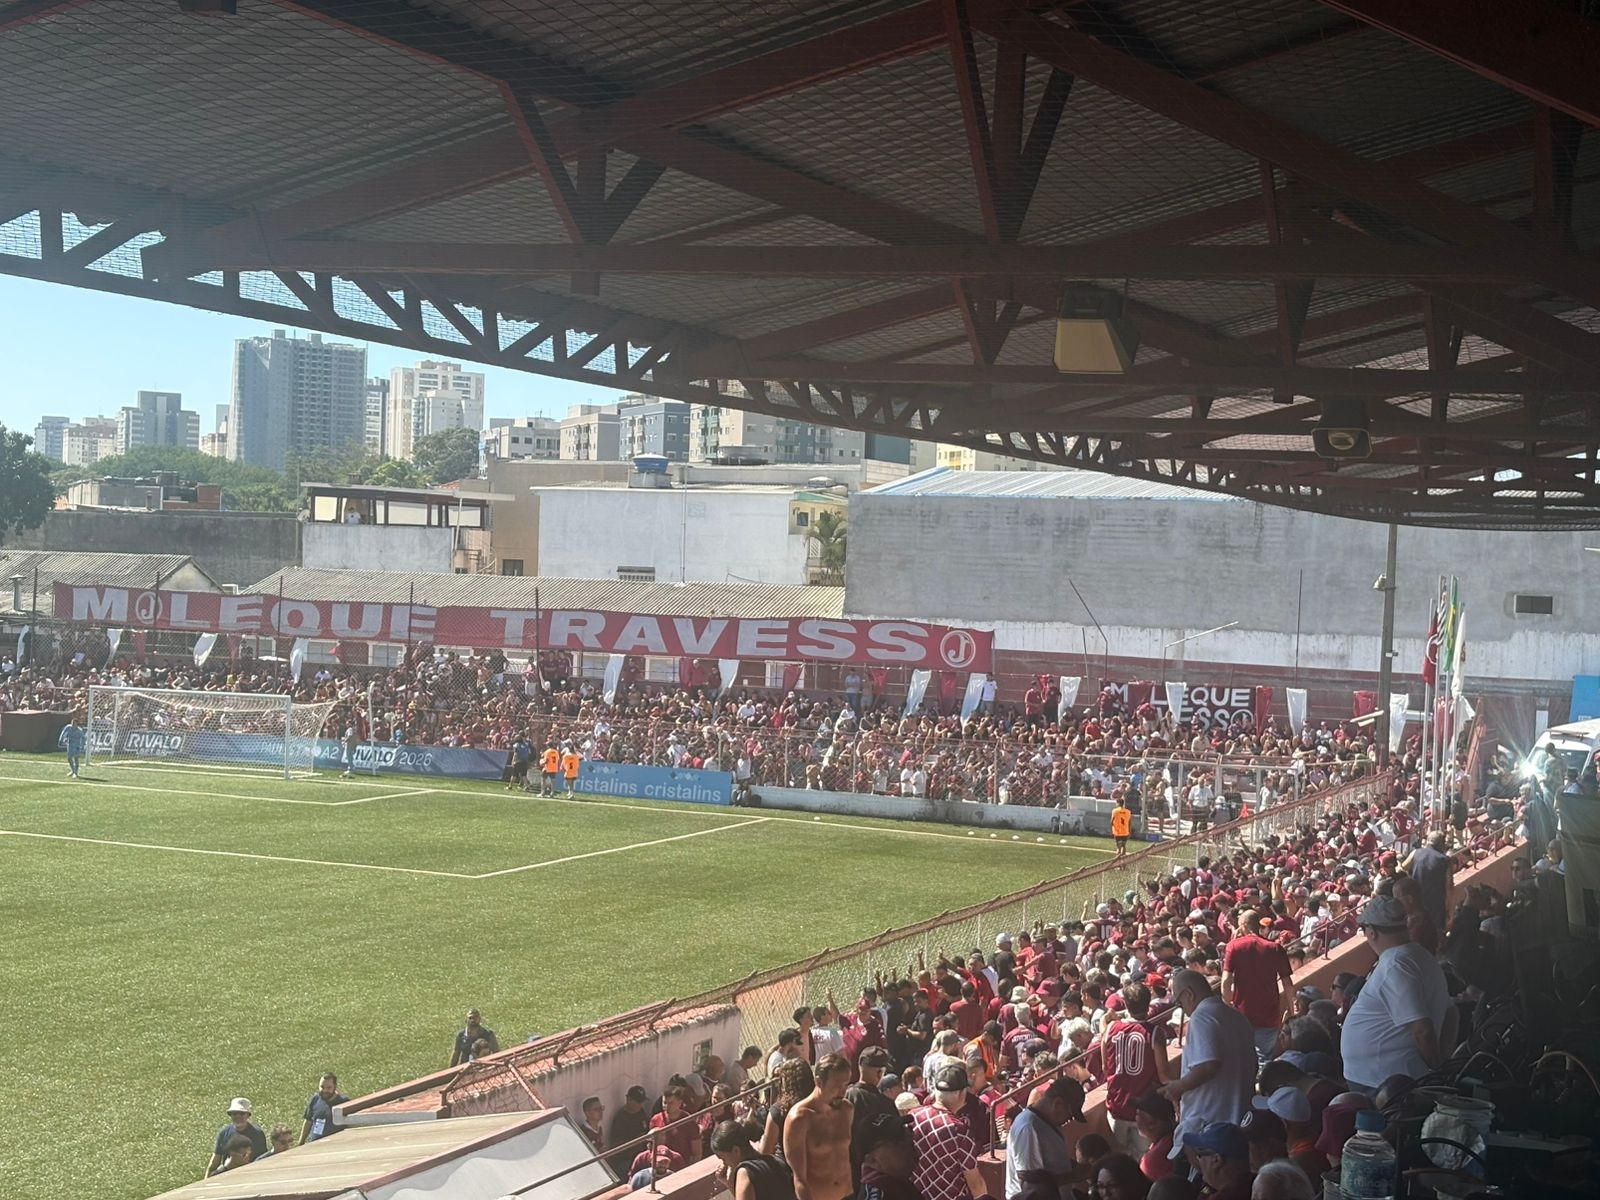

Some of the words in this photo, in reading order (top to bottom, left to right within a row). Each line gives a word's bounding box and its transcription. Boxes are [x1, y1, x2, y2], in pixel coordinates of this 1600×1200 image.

[1110, 682, 1251, 707] MLEQUE
[127, 732, 182, 749] RIVALO
[320, 745, 340, 760] A2
[354, 748, 394, 763] IVALO
[399, 751, 433, 767] 2026
[644, 782, 722, 802] cristalins
[1111, 1030, 1146, 1076] 10
